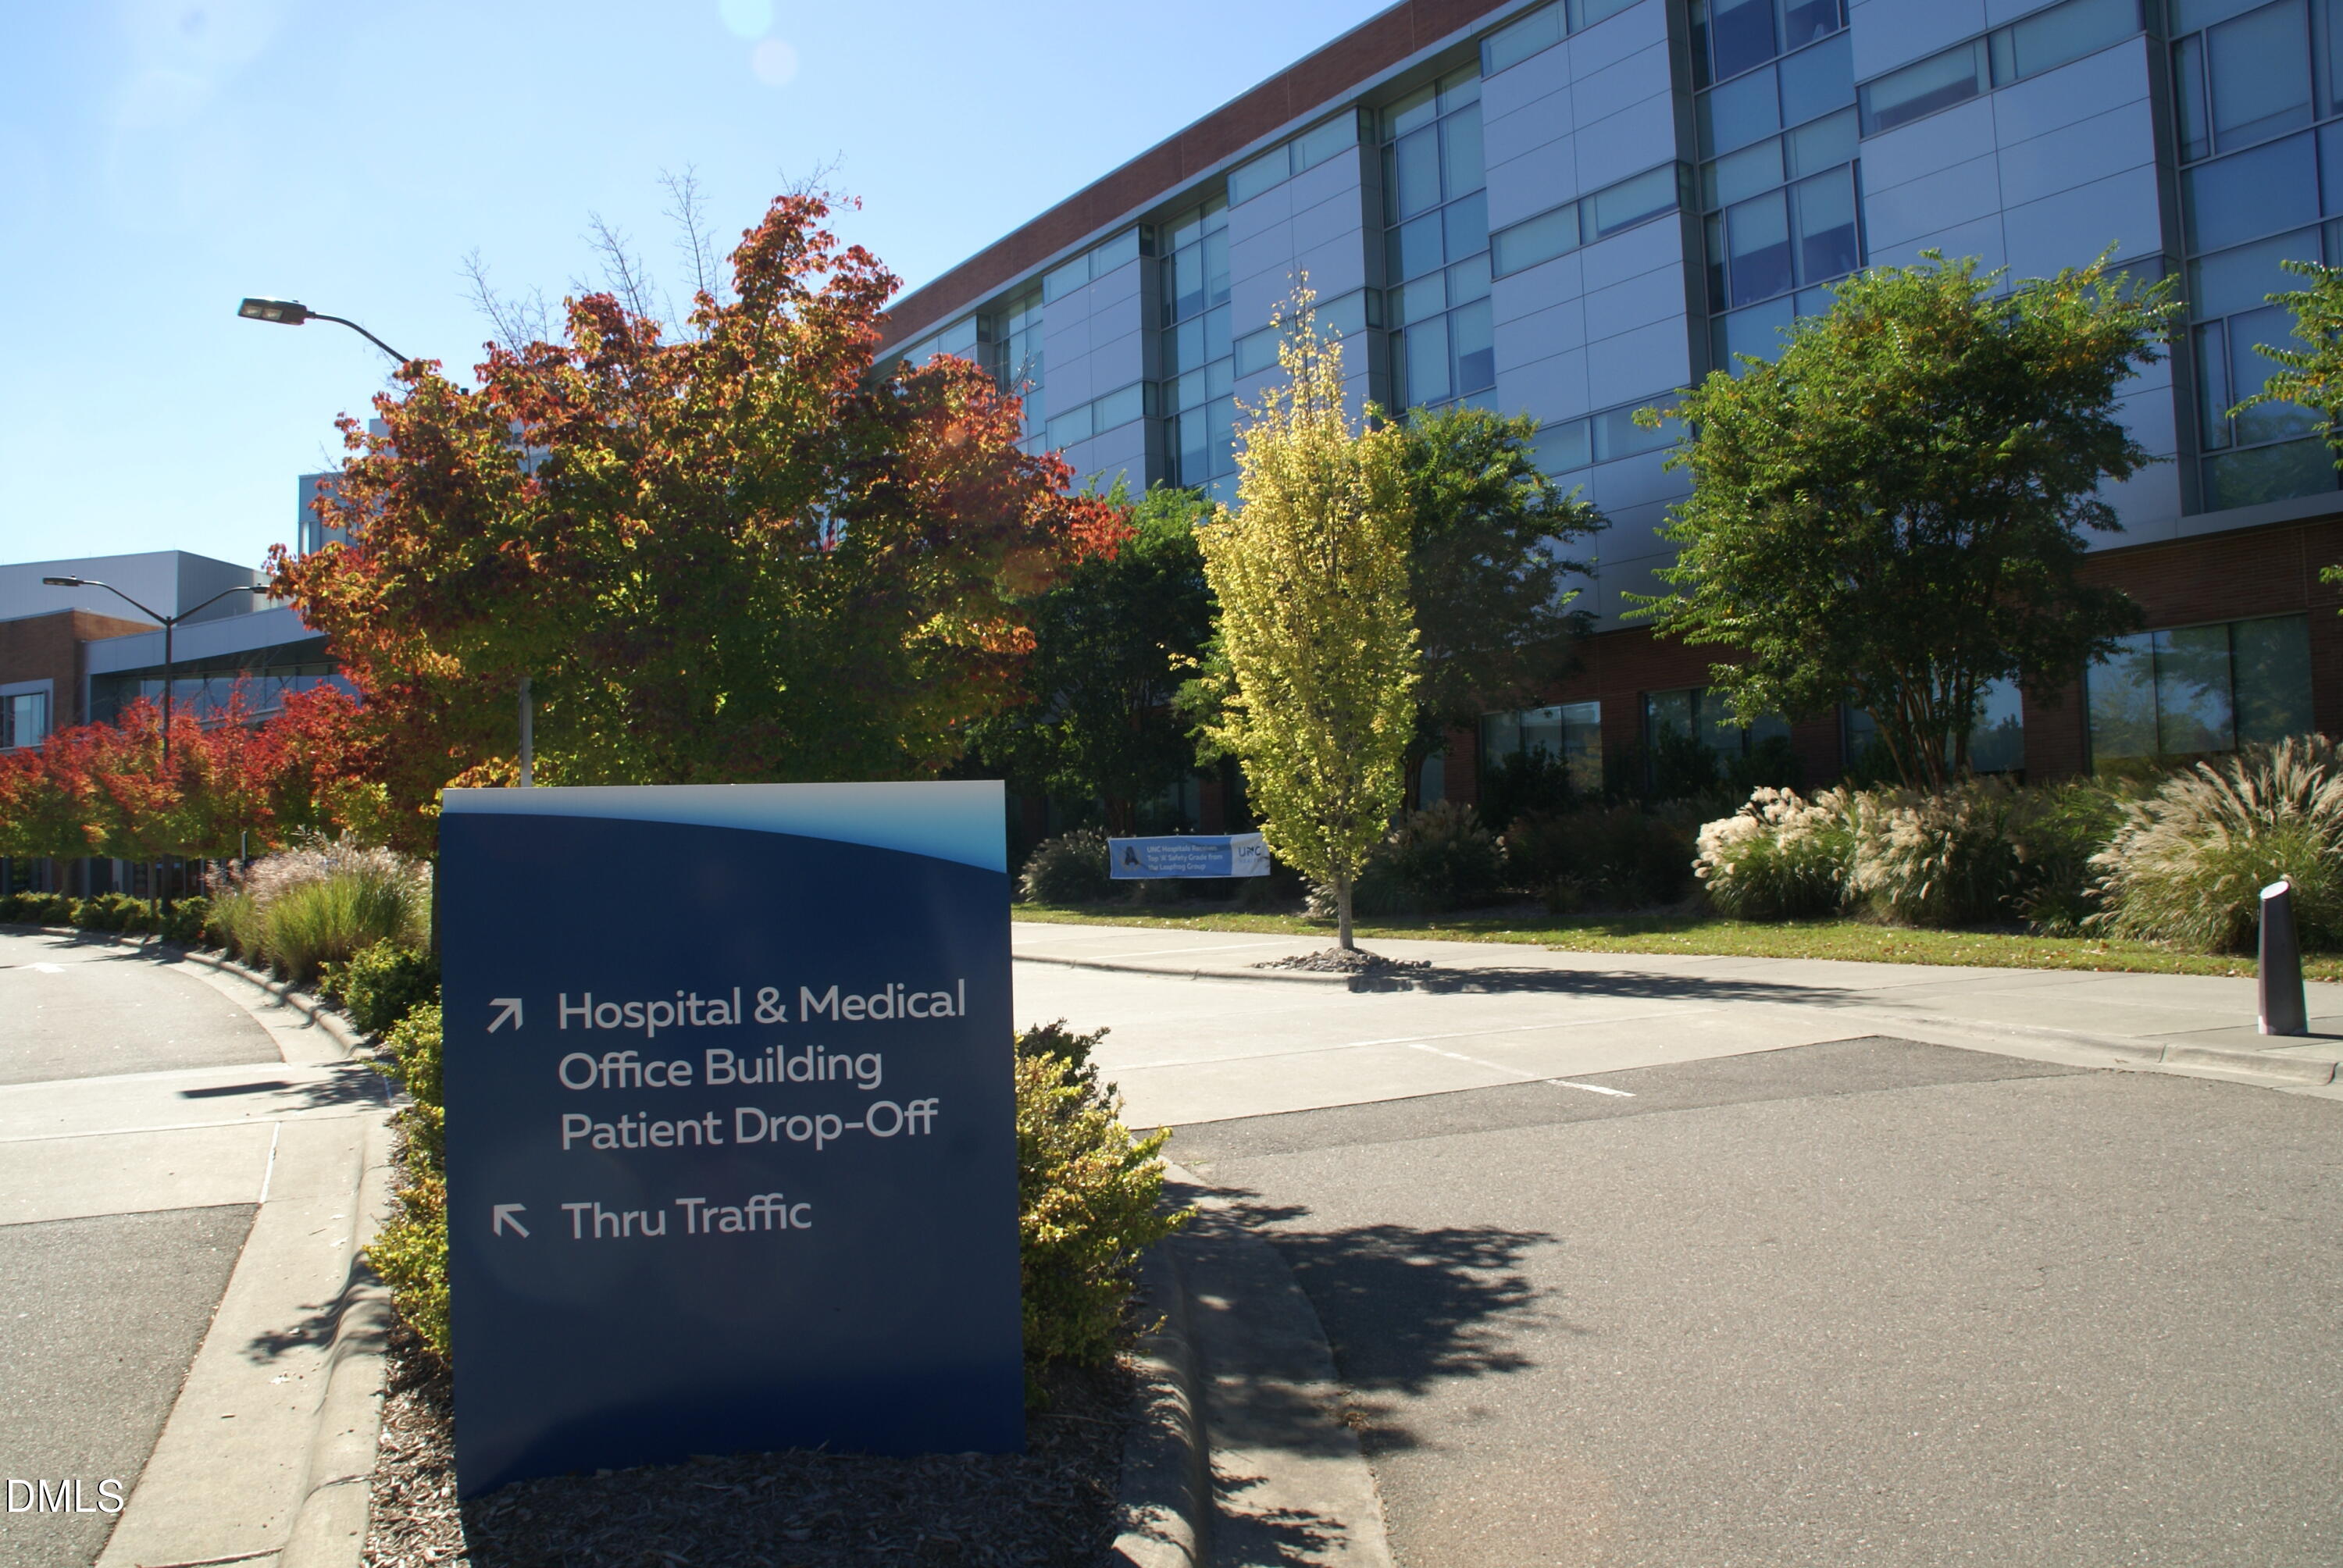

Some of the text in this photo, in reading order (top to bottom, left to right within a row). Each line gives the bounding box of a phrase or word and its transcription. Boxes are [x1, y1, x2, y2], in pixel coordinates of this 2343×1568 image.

[1125, 846, 1139, 865] A
[1239, 846, 1261, 857] UNC
[558, 978, 966, 1038] Hospital & Medical
[558, 1045, 882, 1090] Office Building
[562, 1097, 939, 1151] Patient Drop-Off
[561, 1192, 812, 1239] Thru Traffic
